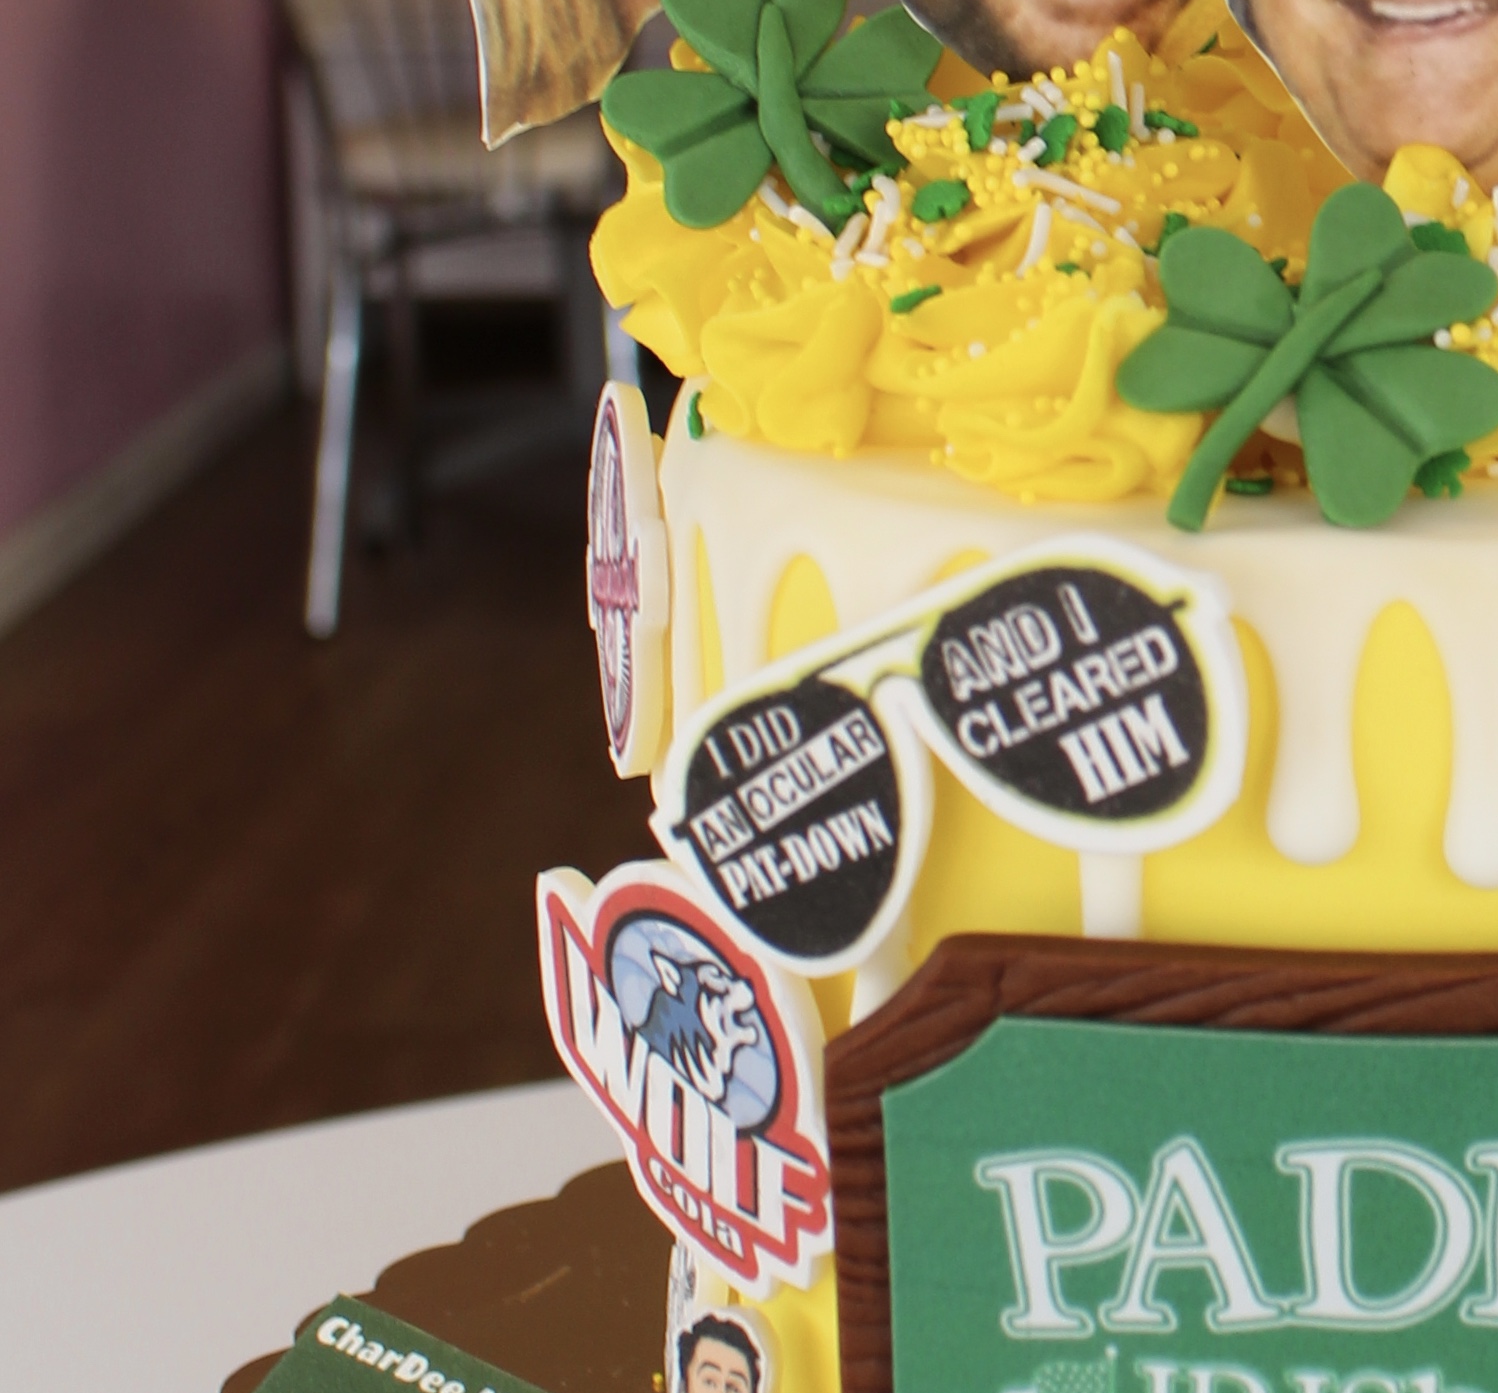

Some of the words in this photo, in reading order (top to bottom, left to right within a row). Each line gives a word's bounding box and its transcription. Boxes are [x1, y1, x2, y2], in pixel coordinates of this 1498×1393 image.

[941, 604, 1062, 703] AND
[1057, 581, 1099, 645] I
[957, 625, 1179, 758] CLEARED
[700, 807, 752, 857] AN
[746, 719, 879, 821] OCULAR
[705, 735, 732, 778] I
[727, 706, 802, 770] DID
[1058, 693, 1190, 804] HIM
[717, 799, 895, 910] PAT-DOWN
[562, 924, 817, 1245] WOLF
